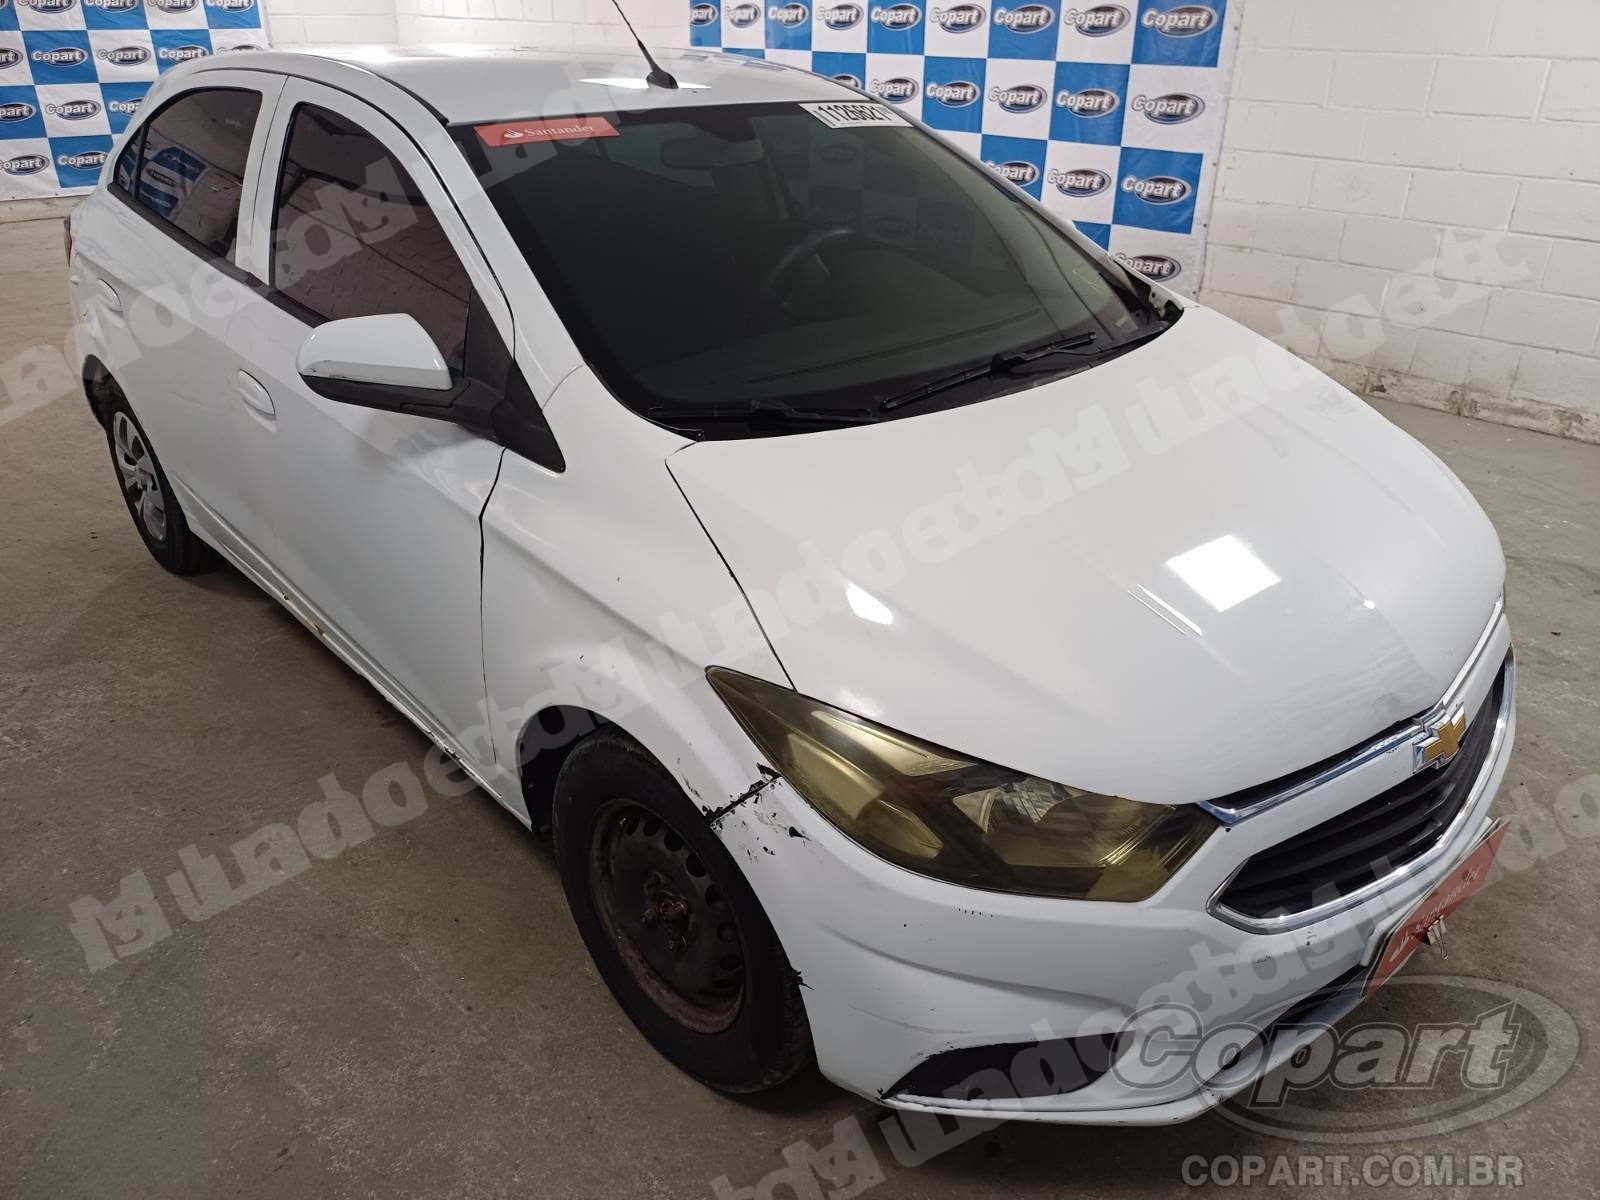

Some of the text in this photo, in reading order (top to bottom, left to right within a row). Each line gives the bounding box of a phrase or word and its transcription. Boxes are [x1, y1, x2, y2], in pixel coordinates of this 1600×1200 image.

[816, 7, 858, 24] Copart
[871, 7, 917, 24] Copart
[930, 8, 980, 25] Copart
[994, 9, 1047, 26] Copart
[1064, 10, 1121, 28] Copart
[1142, 10, 1209, 31] Copart
[32, 50, 82, 63] Copart
[97, 48, 145, 62] Copart
[159, 47, 203, 61] Copart
[870, 80, 913, 98] Copart
[927, 84, 974, 103] Copart
[988, 87, 1040, 106] Copart
[1056, 91, 1110, 111] Copart
[1132, 97, 1195, 117] Copart
[46, 104, 93, 116] Copart
[818, 104, 892, 121] 1126621
[523, 125, 594, 137] Santander
[58, 155, 106, 168] Copart
[1048, 169, 1101, 190] Copart
[1122, 176, 1181, 199] Copart
